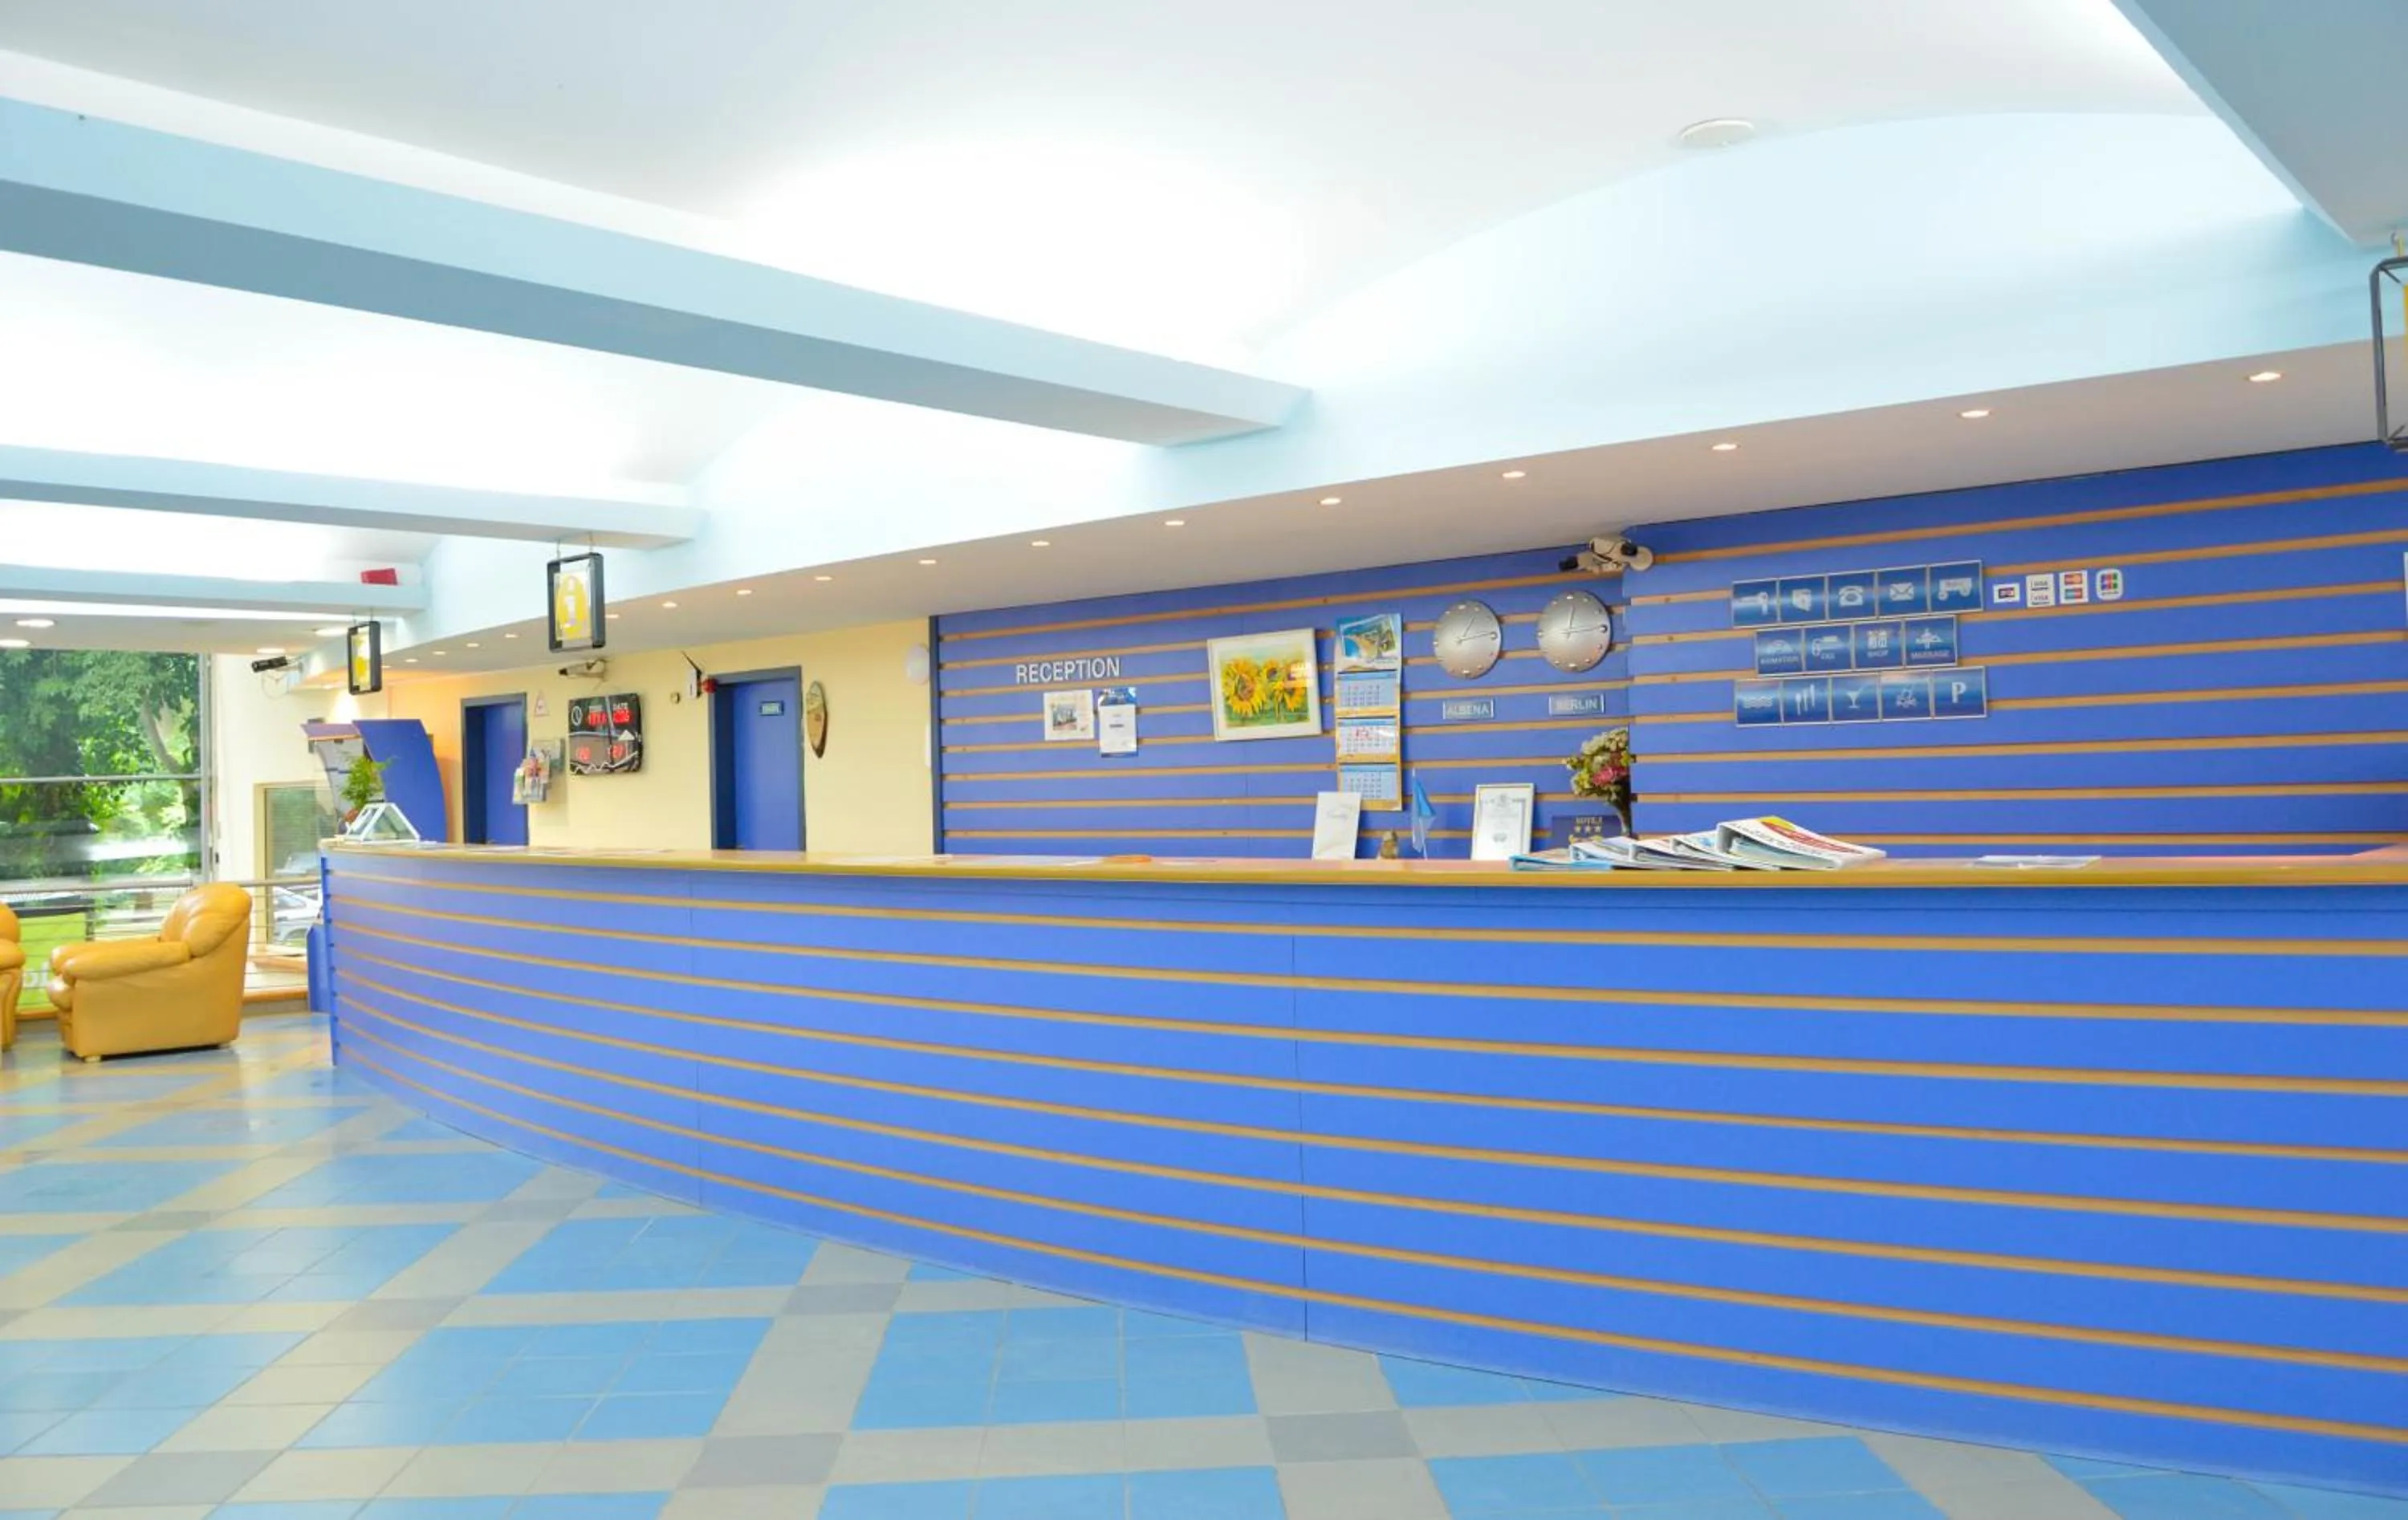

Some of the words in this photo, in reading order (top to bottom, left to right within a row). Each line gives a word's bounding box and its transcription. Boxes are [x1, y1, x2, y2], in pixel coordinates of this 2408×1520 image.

[1015, 656, 1121, 684] RECEPTION
[1446, 702, 1490, 716] ALBENA
[1555, 697, 1597, 711] BERLIN
